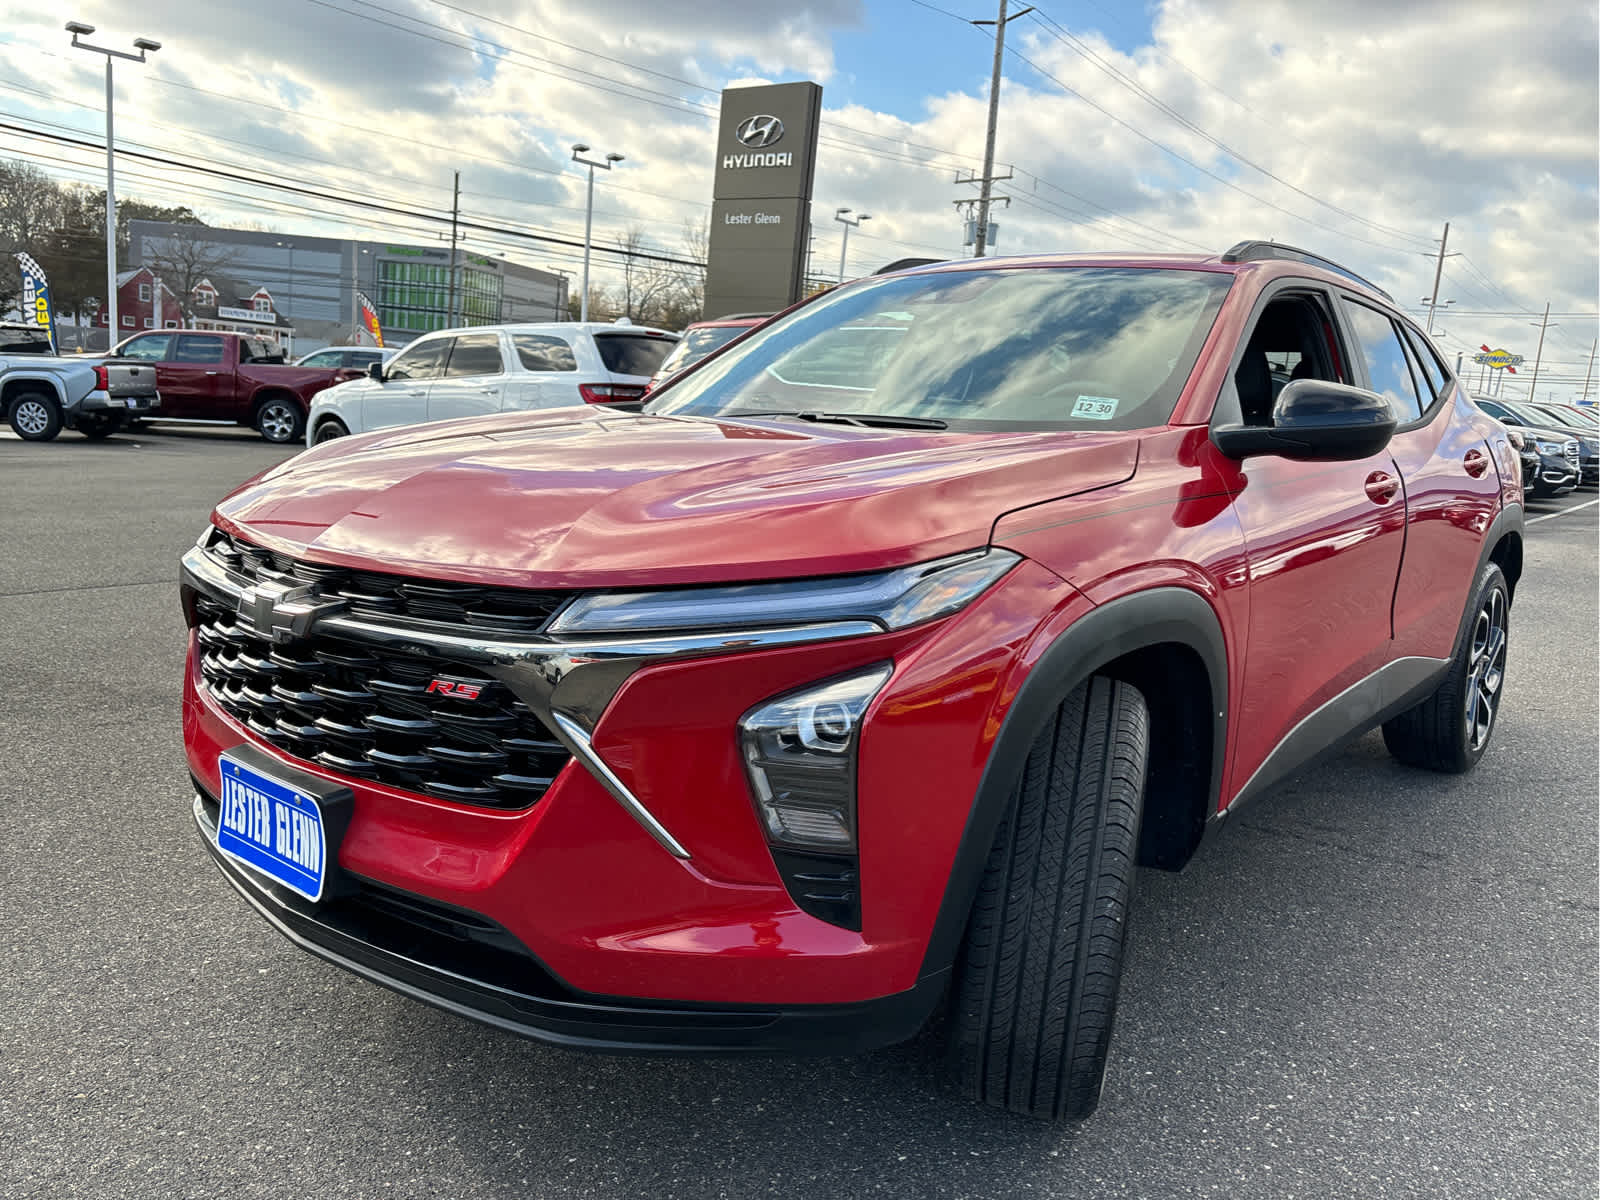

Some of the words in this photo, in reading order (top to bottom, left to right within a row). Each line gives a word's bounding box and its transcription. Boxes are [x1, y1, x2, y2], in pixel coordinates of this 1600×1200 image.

[723, 152, 793, 169] HYUNDAI
[725, 213, 751, 225] Lester
[754, 212, 780, 225] Glenn
[1477, 355, 1521, 365] SUNOCO
[1076, 402, 1093, 412] 12
[1096, 403, 1112, 413] 30
[425, 679, 482, 700] RS
[224, 776, 270, 848] LESTER
[275, 801, 319, 873] GLENN
